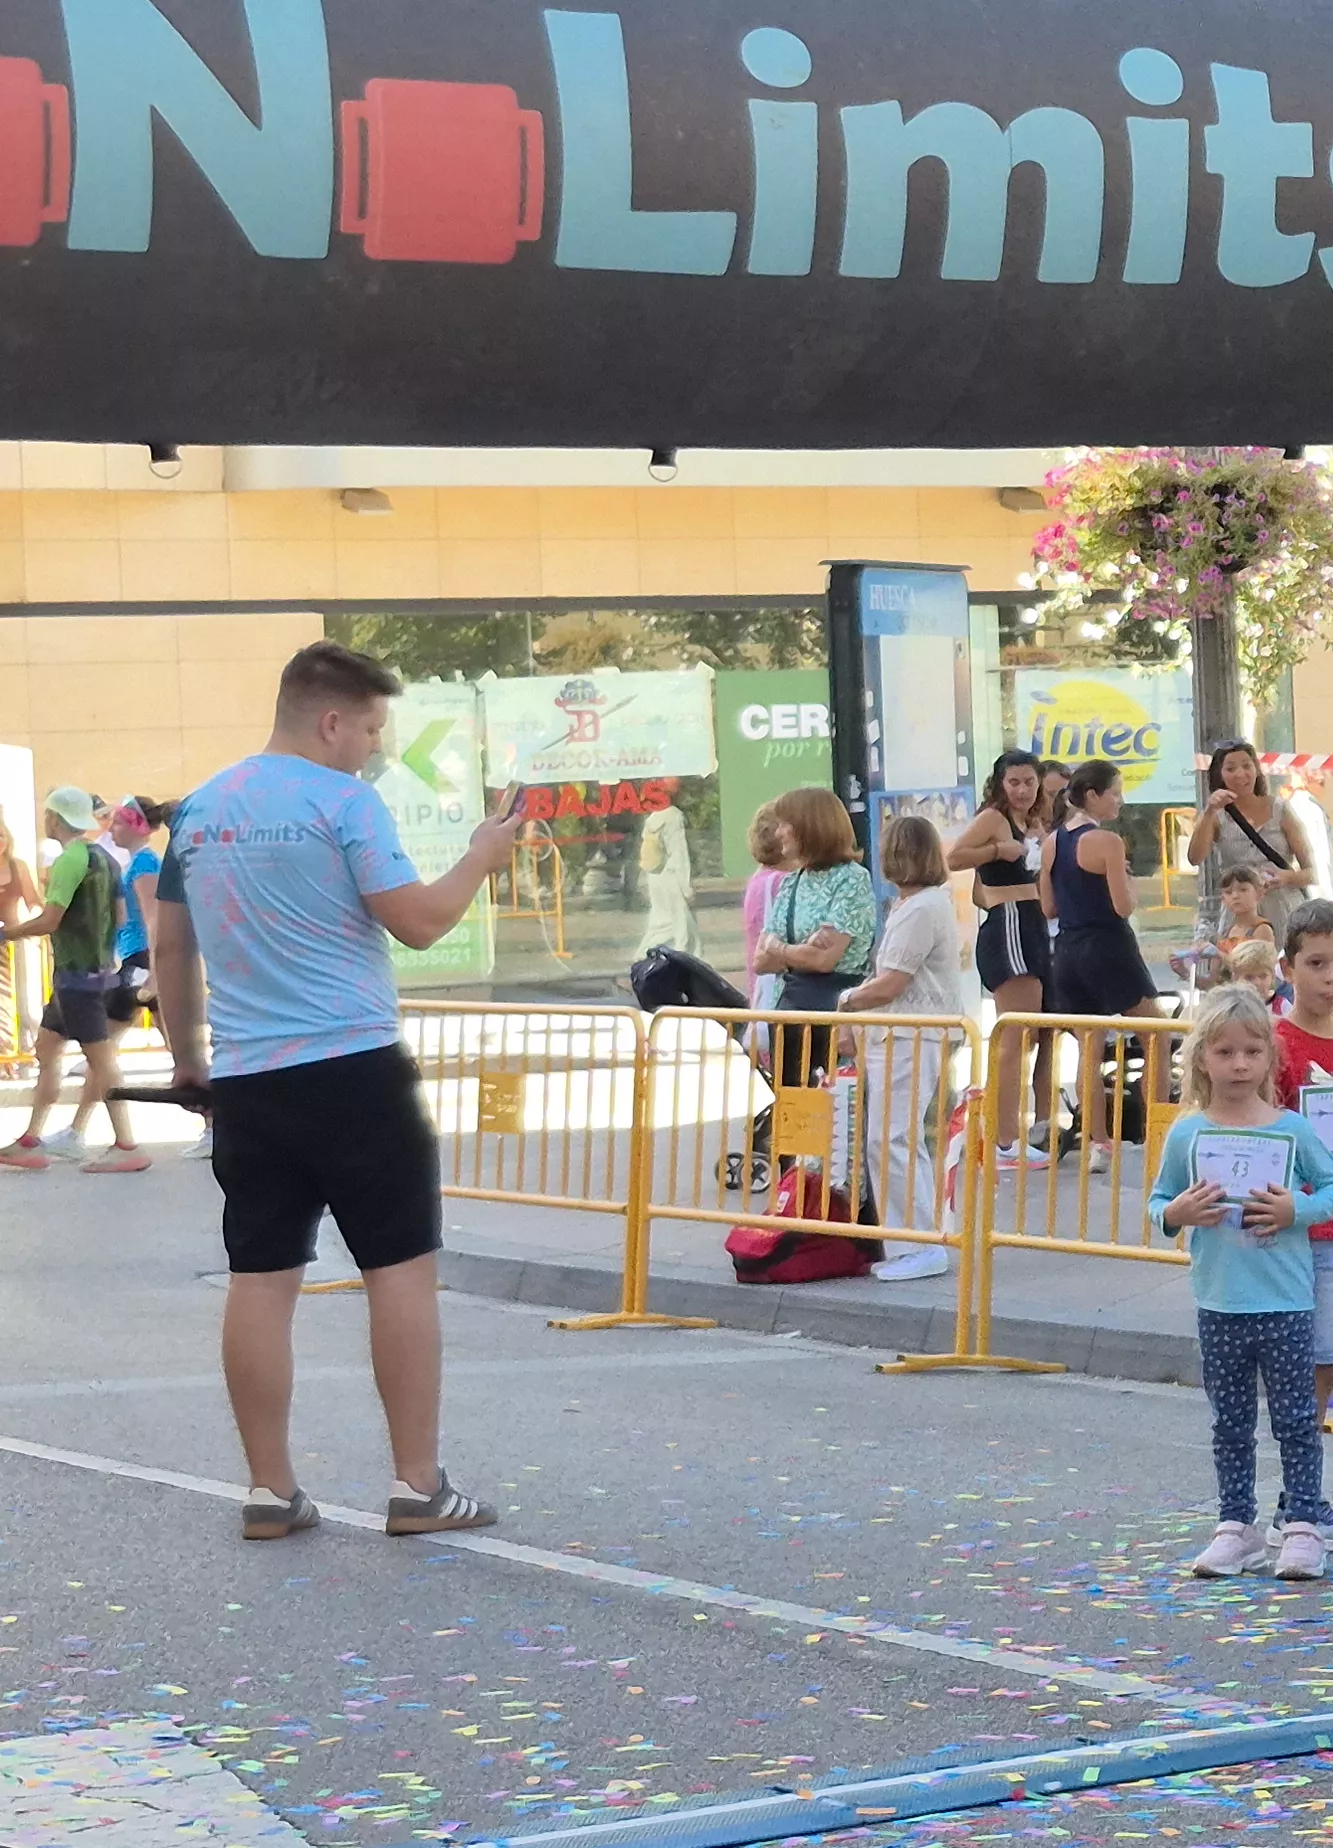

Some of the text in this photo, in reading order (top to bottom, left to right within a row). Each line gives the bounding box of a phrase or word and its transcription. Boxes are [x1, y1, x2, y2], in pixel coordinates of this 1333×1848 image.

[763, 741, 811, 769] por
[494, 778, 671, 821] BAJAS
[1231, 1160, 1250, 1178] 43
